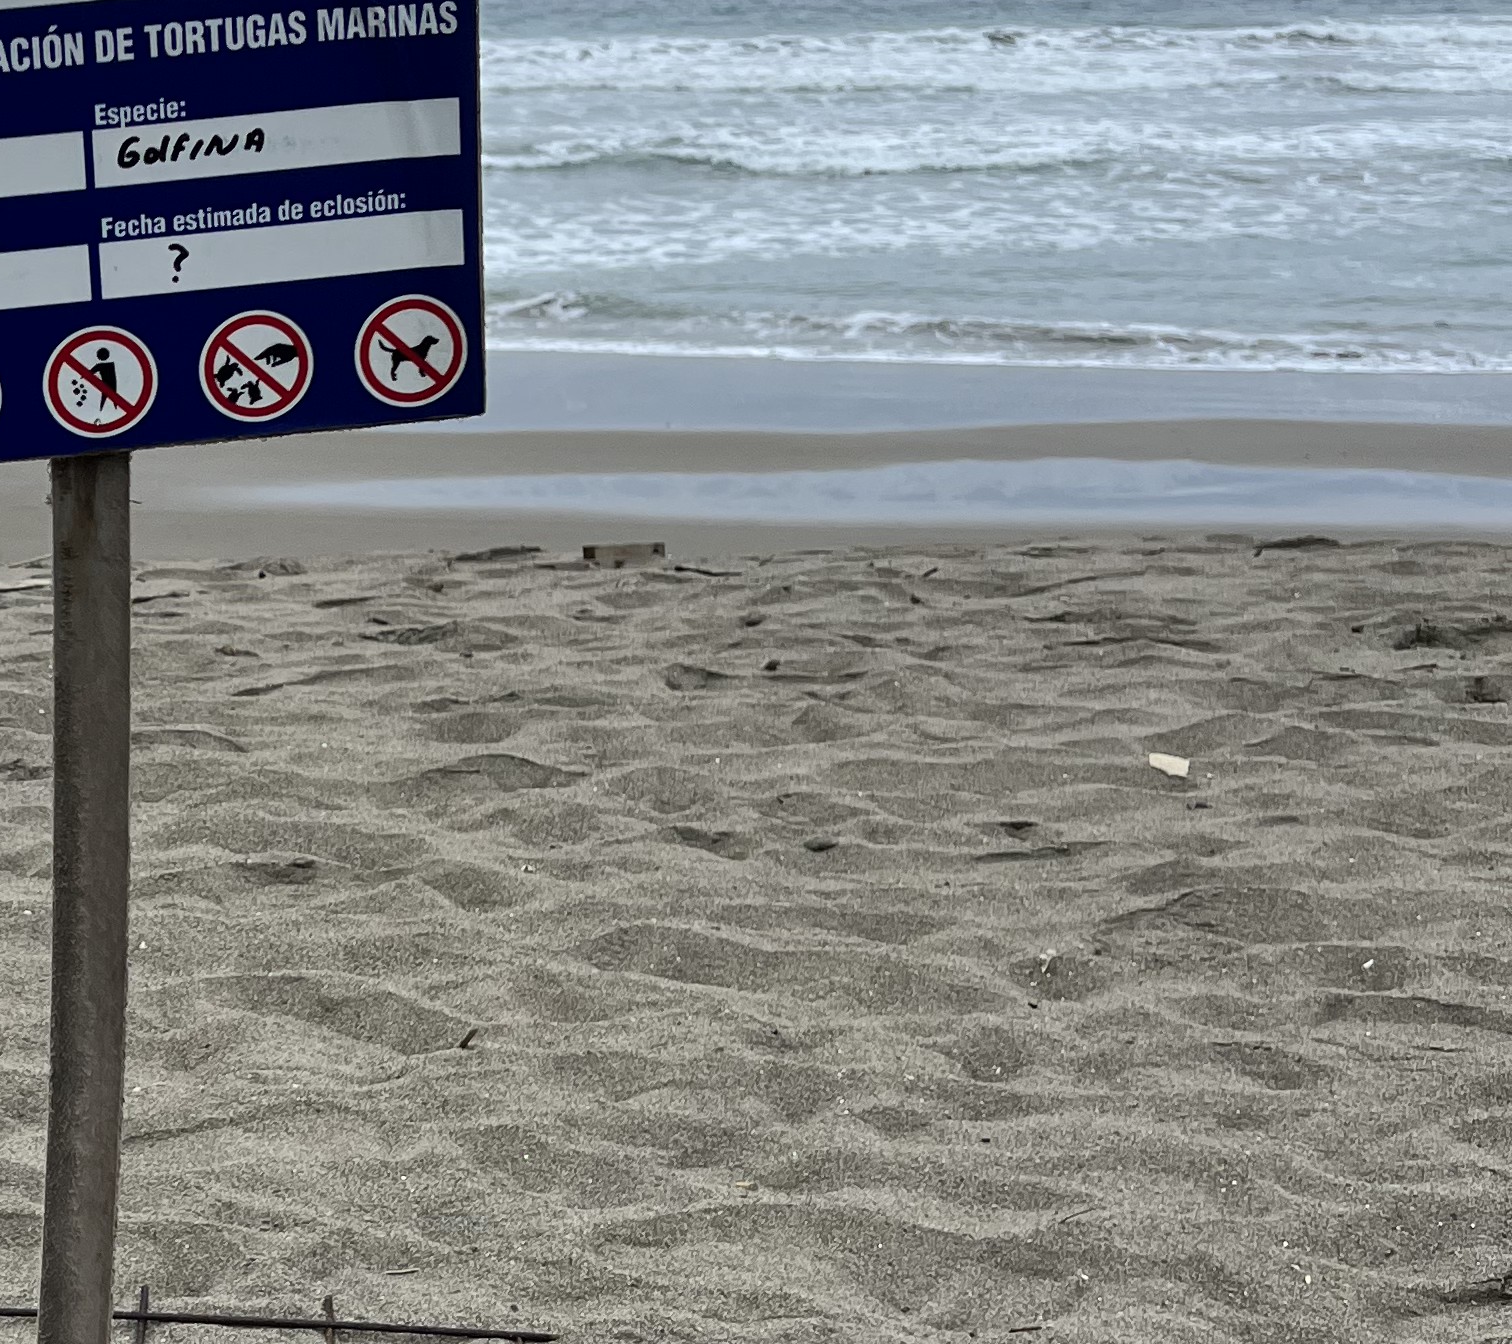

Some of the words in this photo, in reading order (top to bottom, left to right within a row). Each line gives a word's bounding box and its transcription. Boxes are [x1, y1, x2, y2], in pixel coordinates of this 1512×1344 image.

[94, 26, 135, 64] DE
[143, 10, 307, 58] TORTUGAS
[316, 0, 459, 43] MARINAS
[94, 97, 187, 129] Especie:
[100, 214, 166, 239] Fecha
[172, 202, 271, 233] estimada
[278, 199, 304, 222] de
[309, 188, 407, 219] eclosión:
[167, 242, 190, 283] ?
